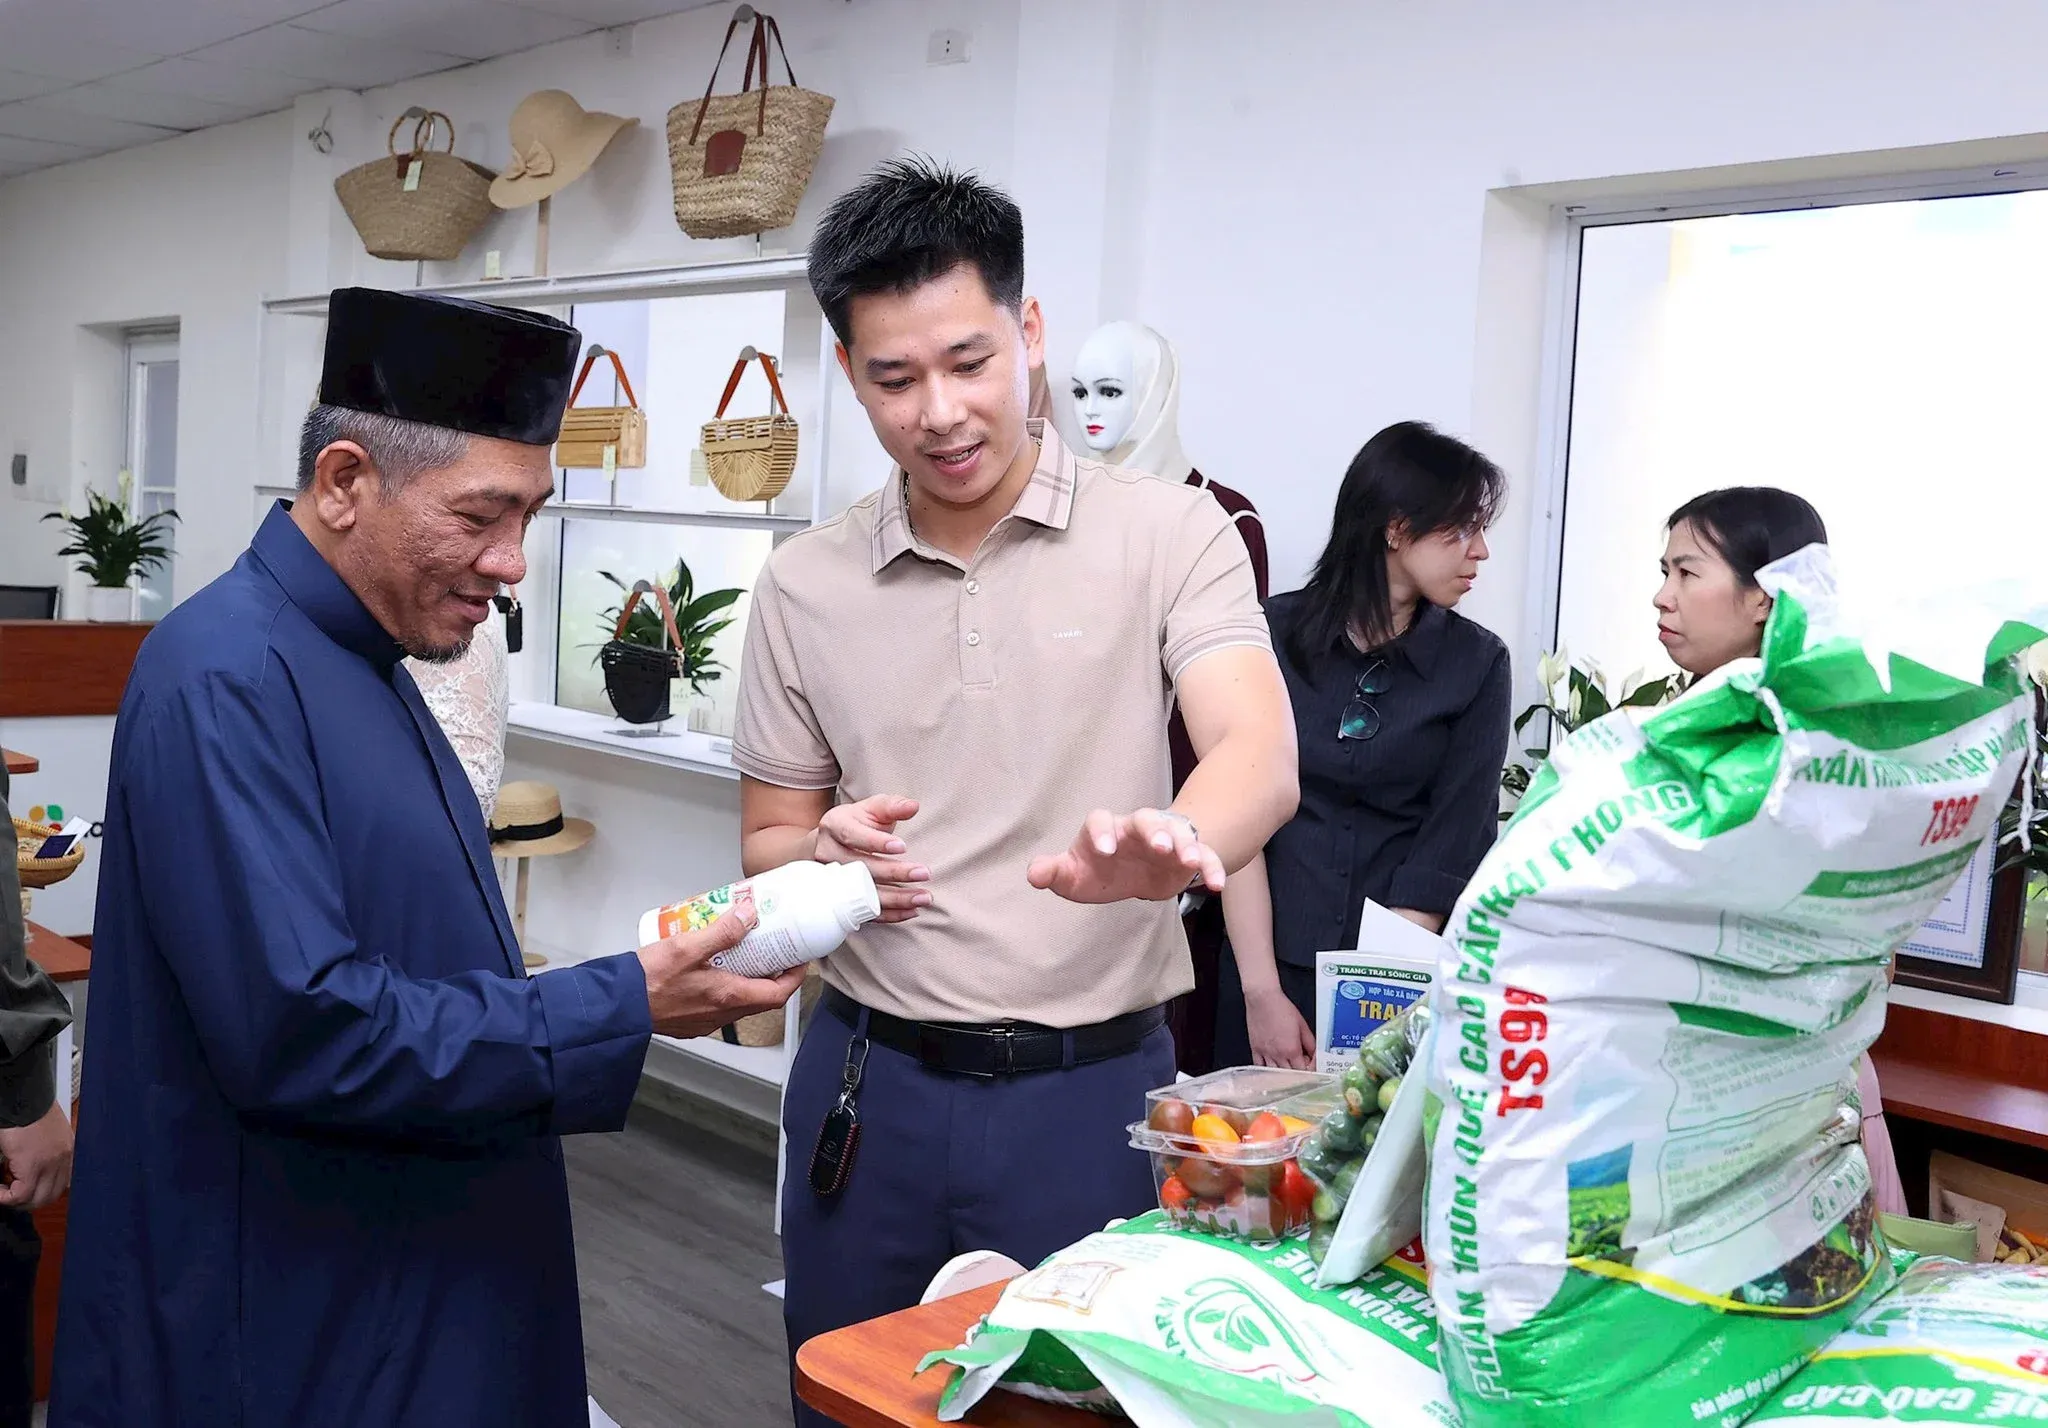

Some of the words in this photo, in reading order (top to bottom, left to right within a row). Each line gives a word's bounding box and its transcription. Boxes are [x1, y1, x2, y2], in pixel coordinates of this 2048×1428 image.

[1340, 966, 1367, 976] TRANG
[1388, 969, 1411, 980] SÔNG
[1455, 907, 1501, 984] CẤP
[1457, 995, 1490, 1074] CAO
[1497, 986, 1549, 1117] TS99
